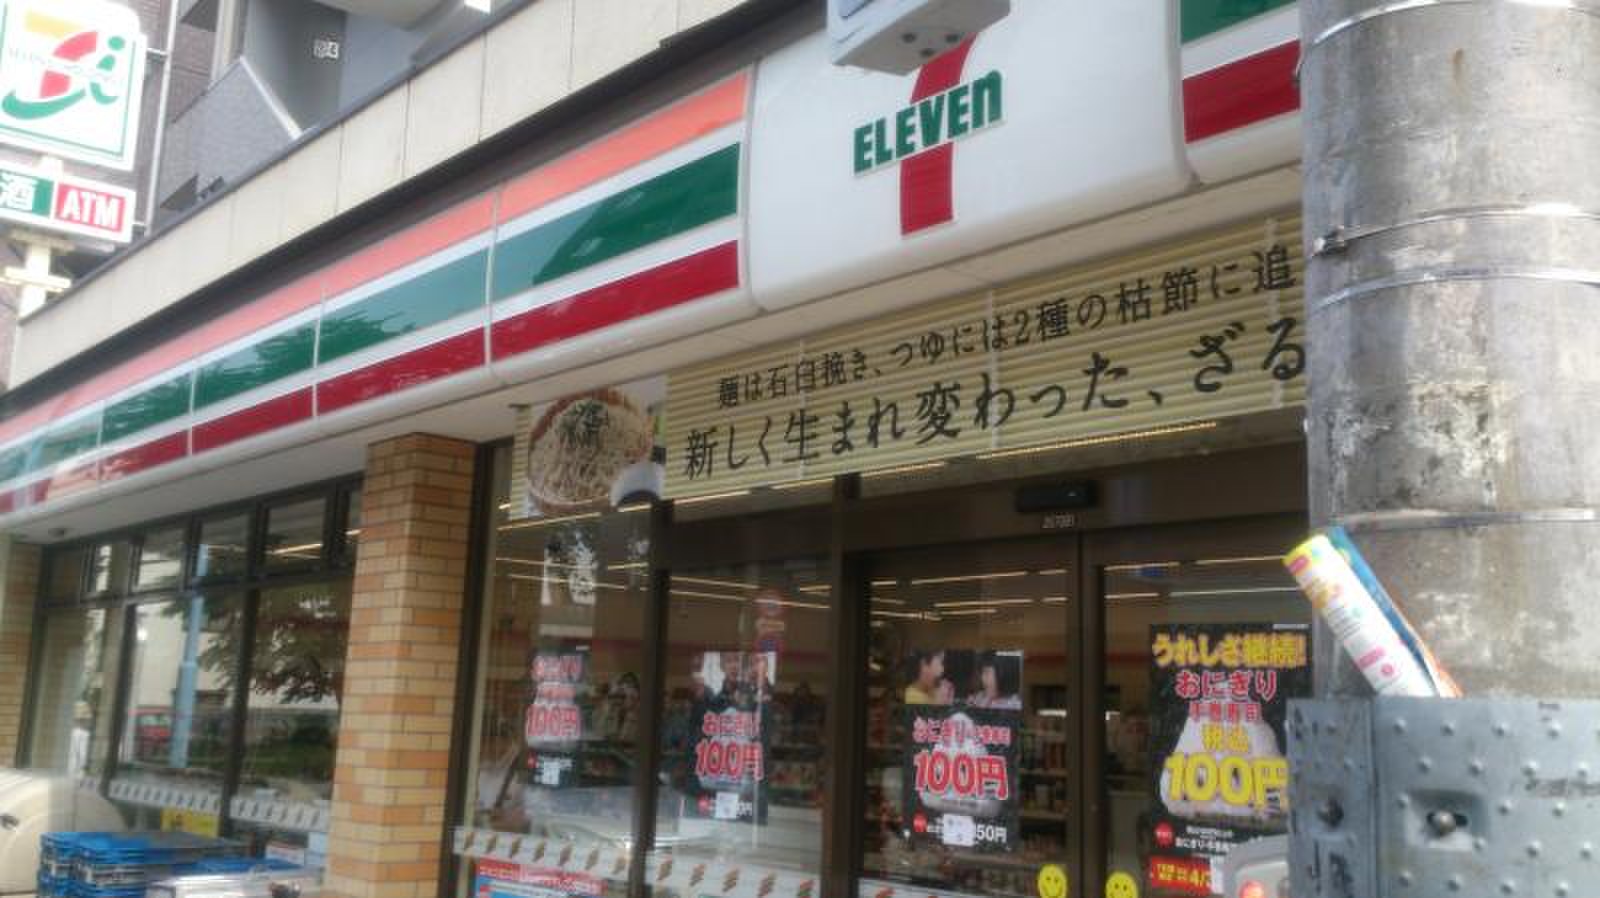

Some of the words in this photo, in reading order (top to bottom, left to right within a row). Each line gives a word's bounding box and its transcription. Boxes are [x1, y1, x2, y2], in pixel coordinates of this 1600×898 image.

[60, 186, 119, 230] ATM
[685, 317, 1305, 481] 新しく生まれ変わった、ざる
[1175, 670, 1277, 700] おにぎり
[696, 739, 764, 781] 100円
[912, 750, 1009, 800] 100円
[1165, 752, 1290, 811] 100円
